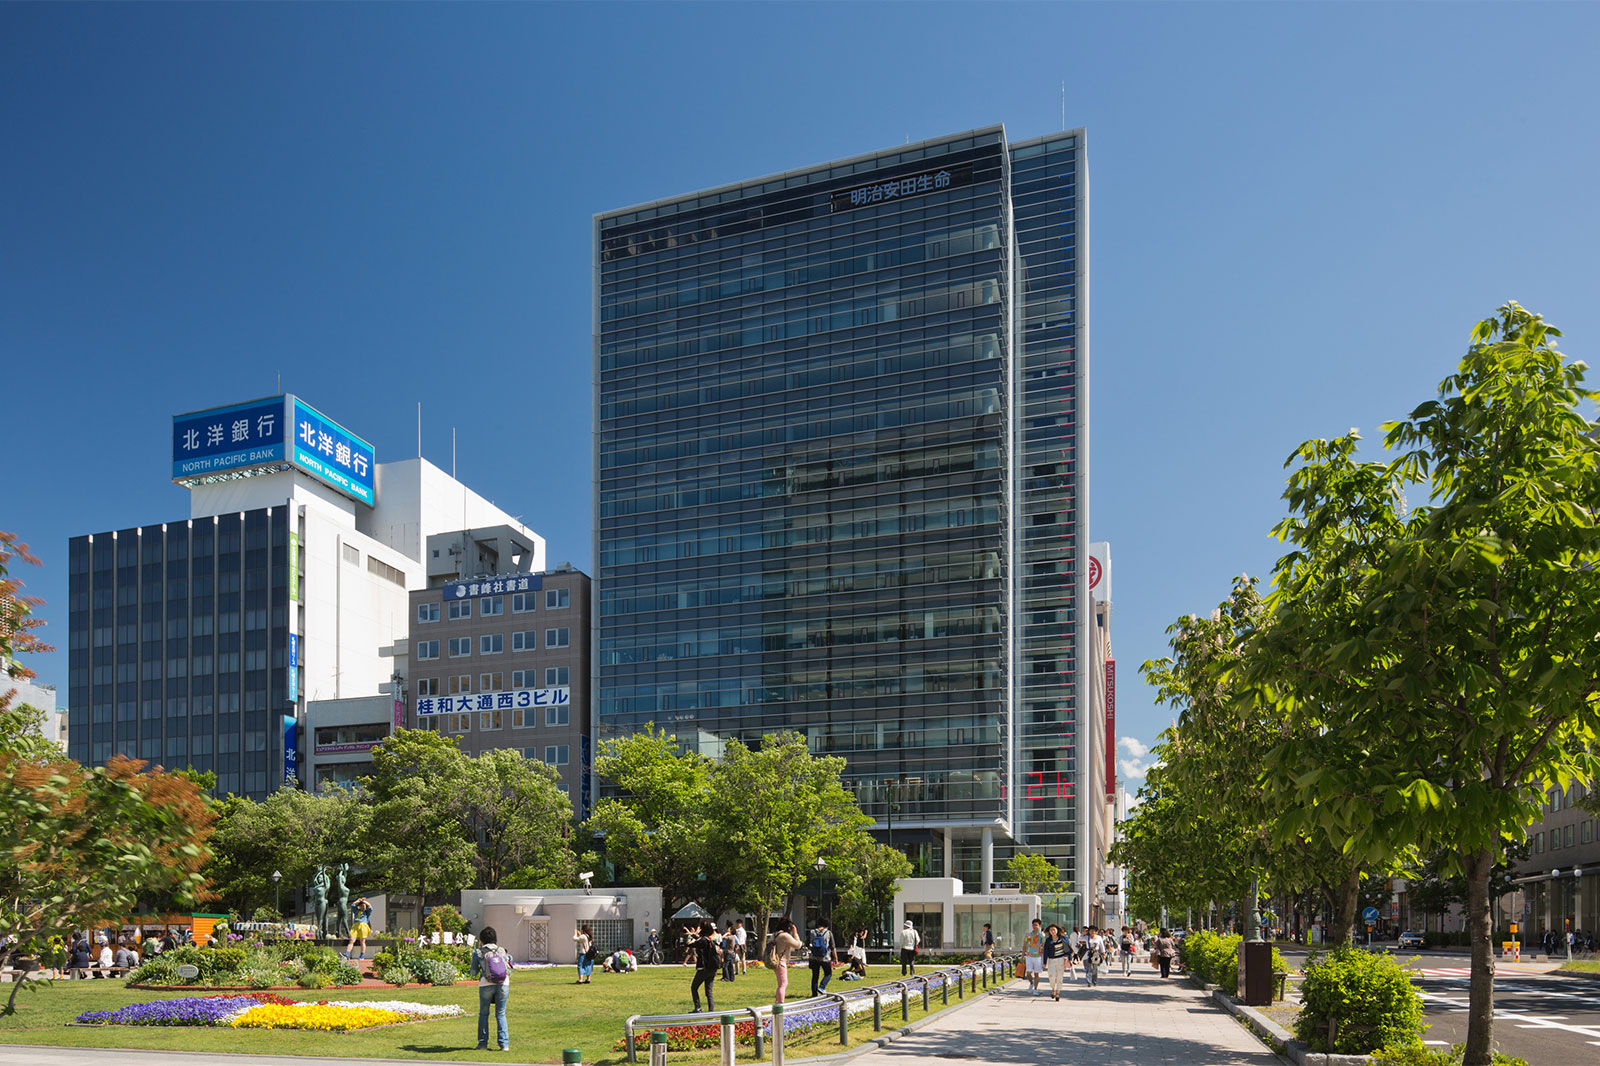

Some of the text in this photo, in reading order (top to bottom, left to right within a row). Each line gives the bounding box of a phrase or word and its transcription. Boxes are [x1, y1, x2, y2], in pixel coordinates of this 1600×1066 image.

[850, 170, 951, 206] 明治安田生命
[182, 414, 275, 451] 北洋銀行
[300, 421, 368, 477] 北洋銀行
[182, 449, 274, 473] NORTH PACIFIC BANK
[299, 453, 368, 498] NORTH PACIFIC BANK
[468, 577, 529, 596] 書峰社書道
[418, 689, 568, 715] 桂和大通西3ビル
